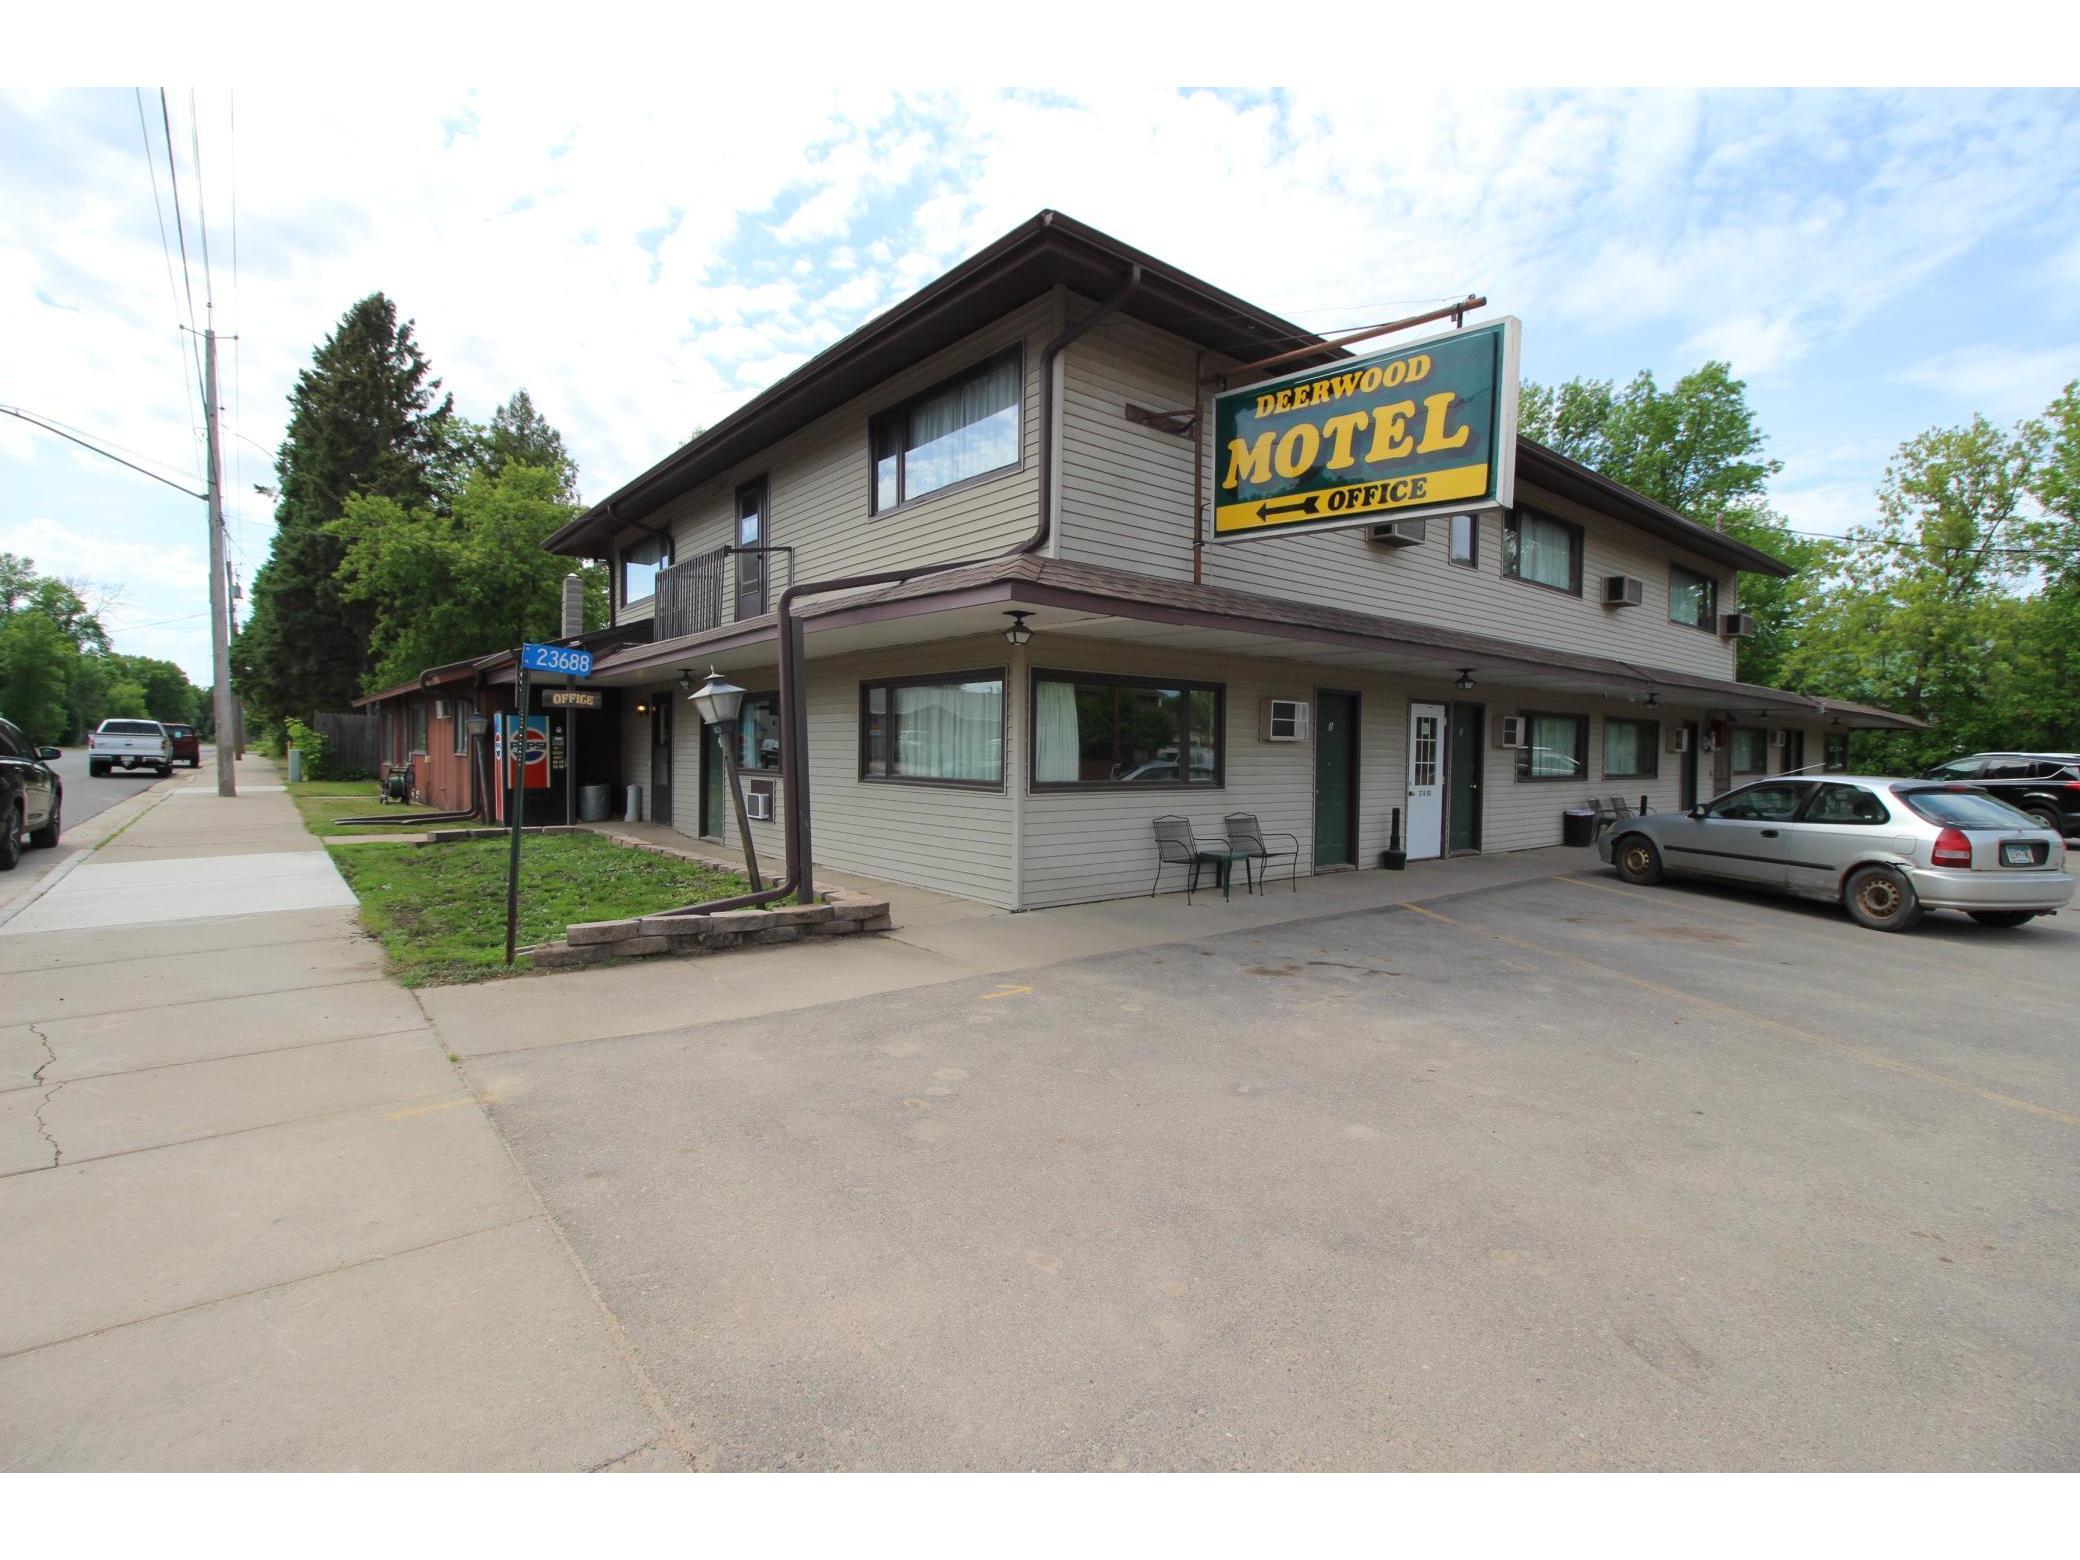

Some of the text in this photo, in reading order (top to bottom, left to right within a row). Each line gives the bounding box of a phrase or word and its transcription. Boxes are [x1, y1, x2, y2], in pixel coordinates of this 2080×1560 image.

[1254, 355, 1431, 419] DEERWOOD
[1222, 392, 1469, 489] MOTEL
[1327, 477, 1428, 511] OFFICE
[536, 648, 590, 672] 23688
[553, 693, 594, 705] OFFICE
[510, 741, 547, 750] PPSI
